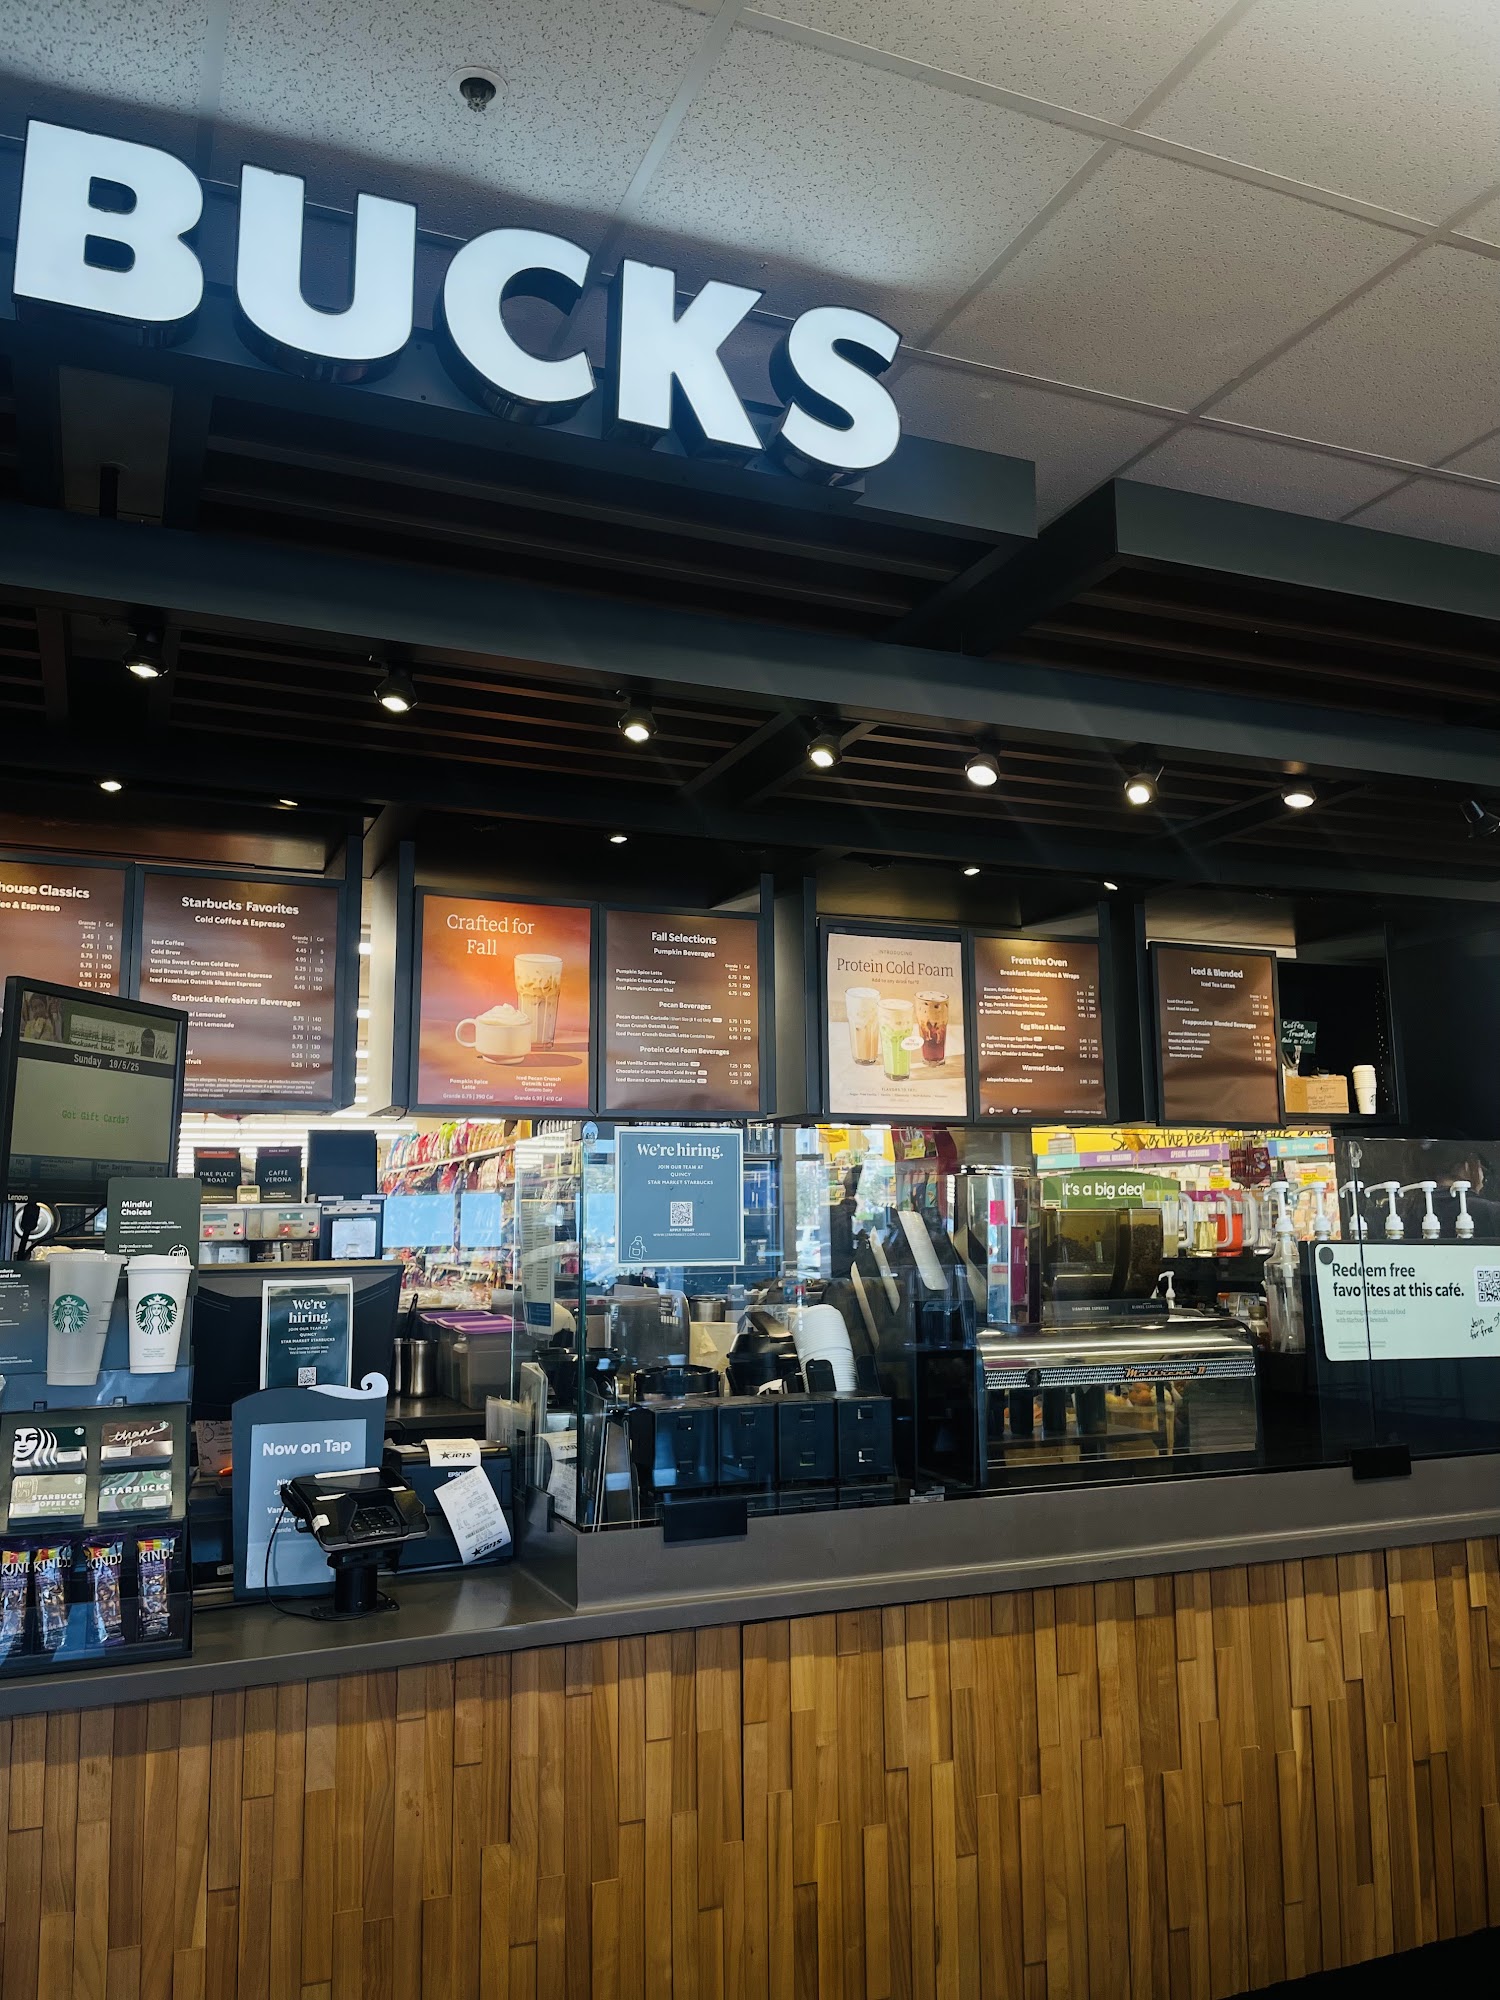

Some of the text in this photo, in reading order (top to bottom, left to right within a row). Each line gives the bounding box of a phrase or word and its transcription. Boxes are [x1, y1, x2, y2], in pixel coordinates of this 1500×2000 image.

[13, 119, 902, 470] BUCKS
[39, 885, 90, 899] Classics
[12, 901, 19, 909] &
[21, 902, 61, 912] Espresso
[181, 896, 299, 915] Starbucks Favorites
[195, 915, 213, 924] Cold
[215, 916, 241, 926] Coffee
[250, 919, 286, 929] Espresso
[446, 914, 535, 935] Crafted for
[165, 939, 185, 947] Coffee
[651, 931, 717, 945] Fall Selections
[466, 939, 497, 956] Fall
[654, 948, 715, 958] Pumpkin Beverages
[837, 957, 954, 977] Protein Cold Foam
[1010, 956, 1068, 967] From the Oven
[184, 969, 200, 977] Sugar
[247, 972, 272, 980] Espresso
[1000, 969, 1026, 977] Breakfast
[1062, 972, 1080, 980] Wraps
[1191, 967, 1243, 978] Iced & Blended
[236, 981, 262, 989] Espresso
[171, 993, 301, 1009] Starbucks Refreshers Beverages
[679, 1002, 712, 1010] Beverages
[1020, 1023, 1031, 1031] Egg
[1234, 1021, 1256, 1030] Beverages
[1282, 1021, 1305, 1030] Coffee
[698, 1048, 730, 1056] Beverages
[74, 1053, 140, 1072] Sunday 10/5/25
[61, 1110, 130, 1124] Got Gift Cards?
[637, 1142, 724, 1160] We're hiring.
[1170, 1149, 1187, 1159] SPECIAL
[1062, 1182, 1080, 1195] It's
[1082, 1185, 1092, 1195] a
[1095, 1182, 1115, 1200] big
[7, 1193, 28, 1201] Lenovo
[121, 1200, 153, 1208] Mindful
[120, 1208, 152, 1216] Choices
[1390, 1263, 1416, 1277] free
[1393, 1284, 1406, 1297] at
[1408, 1283, 1432, 1297] this
[1435, 1283, 1465, 1297] café.
[292, 1299, 326, 1310] We're
[288, 1311, 331, 1325] hiring.
[1471, 1317, 1485, 1329] Join
[1480, 1326, 1494, 1335] free
[1125, 1368, 1193, 1378] Mastrena
[262, 1439, 352, 1456] Now on Tap
[103, 1483, 170, 1496] STARBUCKS
[32, 1493, 83, 1501] STARBUCKS
